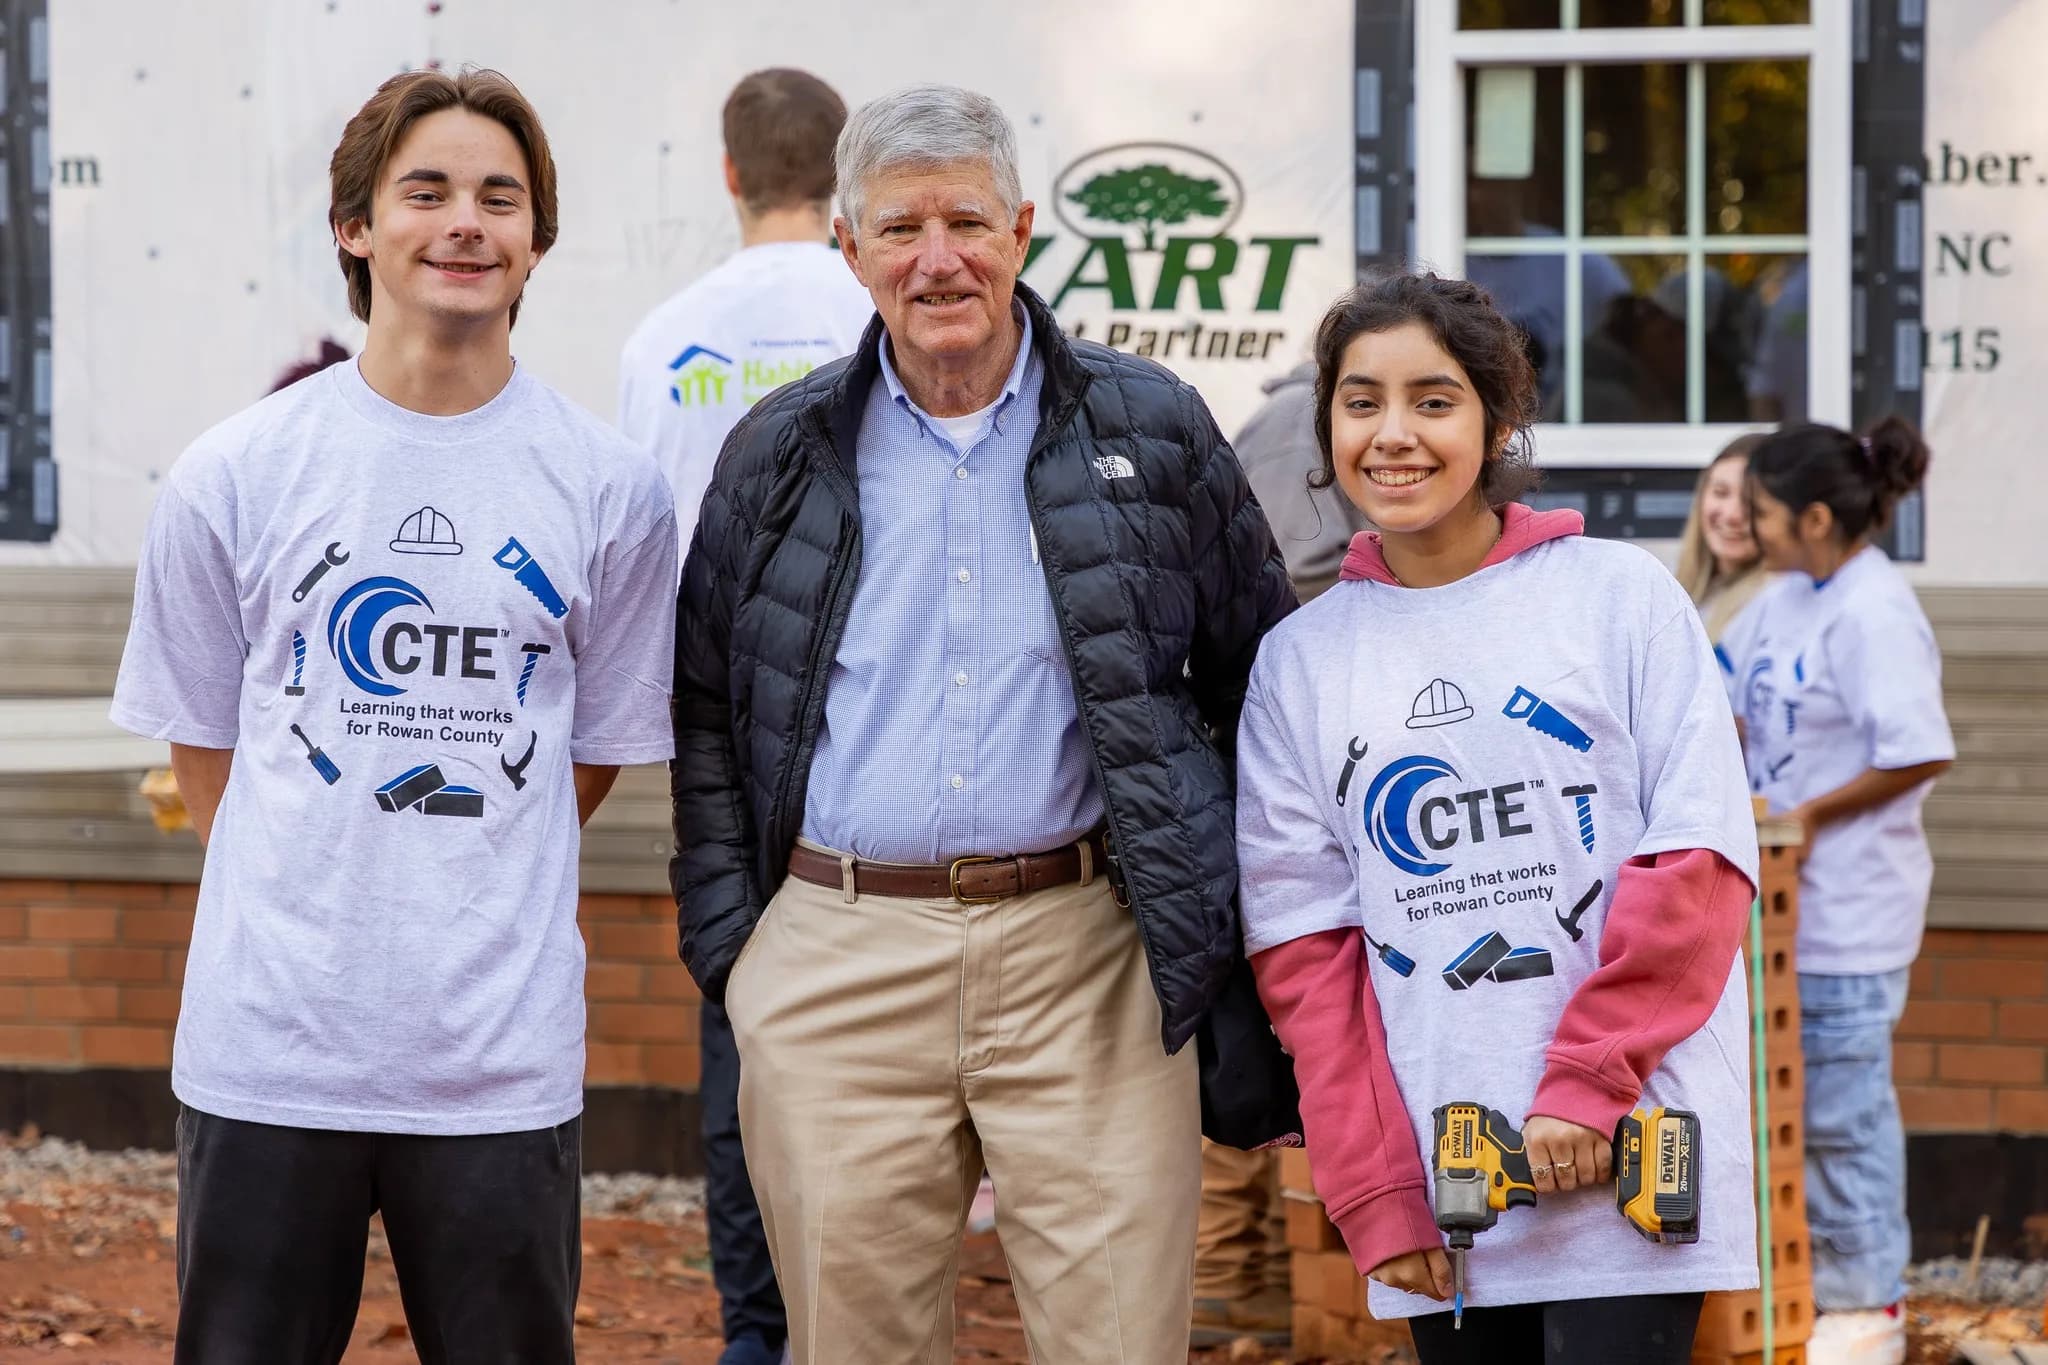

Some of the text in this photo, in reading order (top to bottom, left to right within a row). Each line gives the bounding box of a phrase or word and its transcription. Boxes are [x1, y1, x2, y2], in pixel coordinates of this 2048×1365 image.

[1935, 232, 2012, 277] NC
[1106, 323, 1285, 359] Partner
[340, 698, 513, 724] Learning that works
[347, 719, 505, 748] for Rowan County
[1394, 862, 1557, 903] Learning that works
[1406, 885, 1554, 923] for Rowan County
